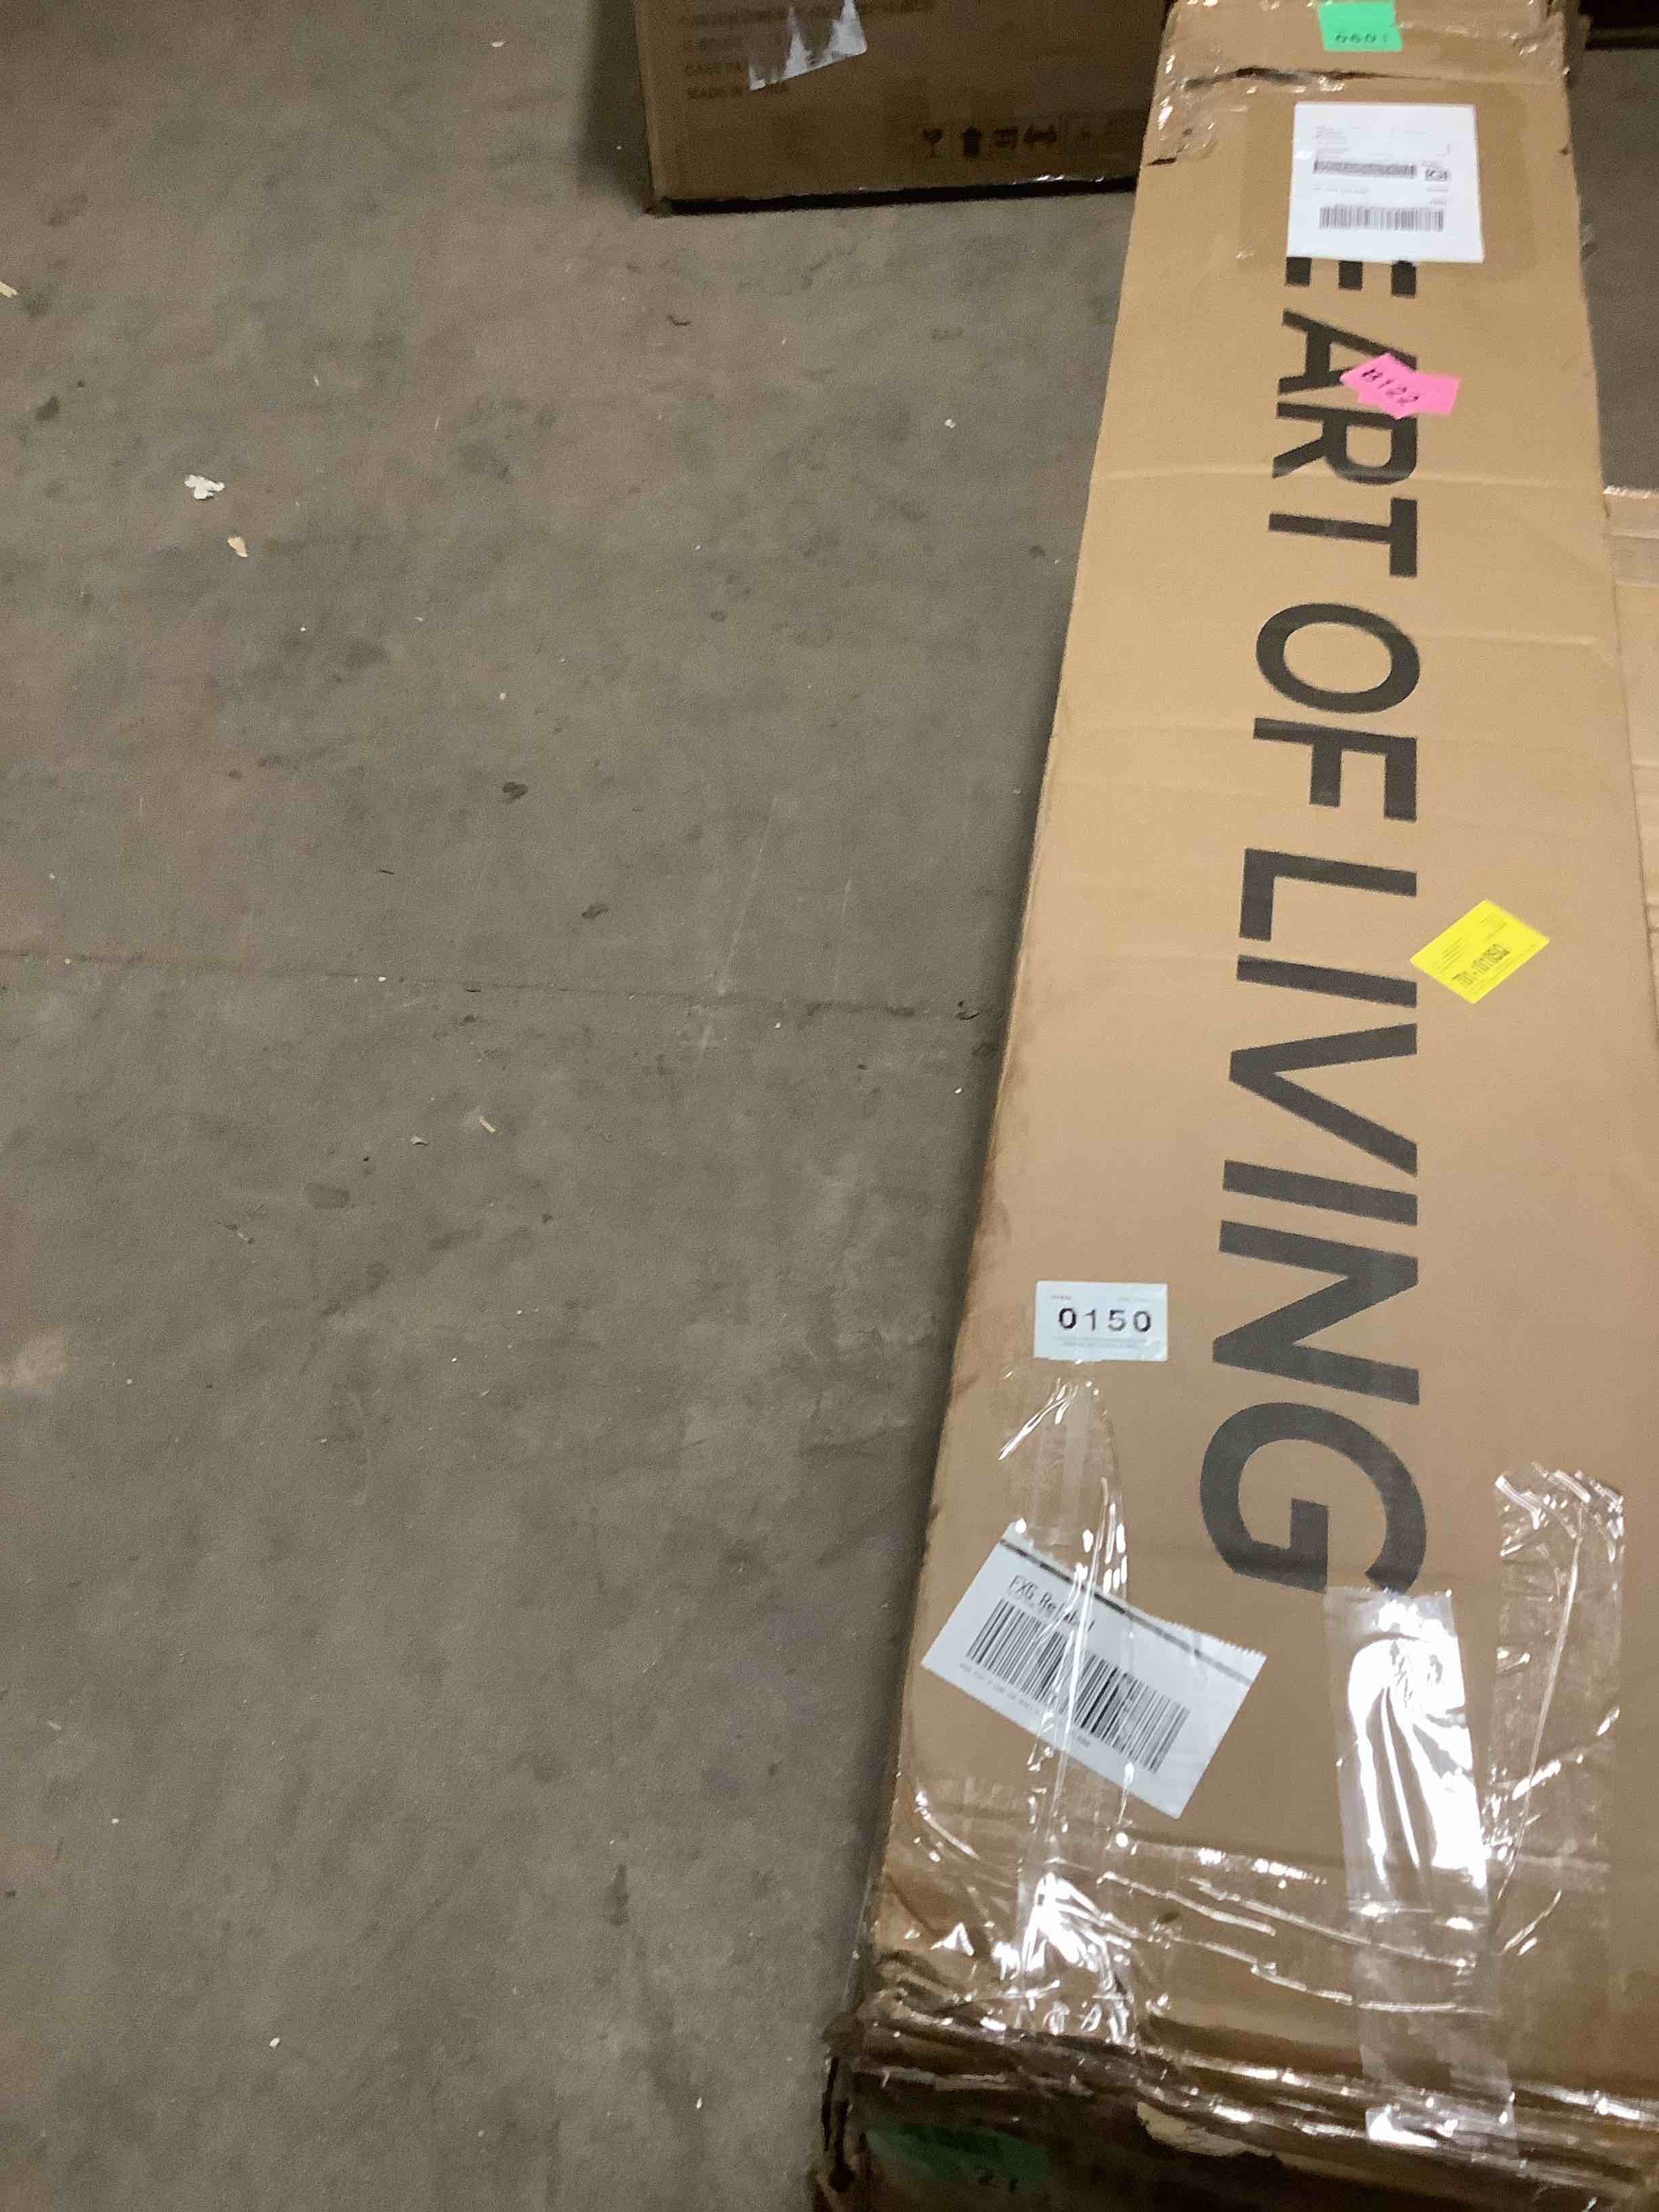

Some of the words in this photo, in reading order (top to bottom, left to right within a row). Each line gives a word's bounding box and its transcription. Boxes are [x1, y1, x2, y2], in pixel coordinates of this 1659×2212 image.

[1253, 602, 1421, 822] OF
[1059, 1307, 1151, 1333] 0150
[1200, 847, 1427, 1593] LIVING
